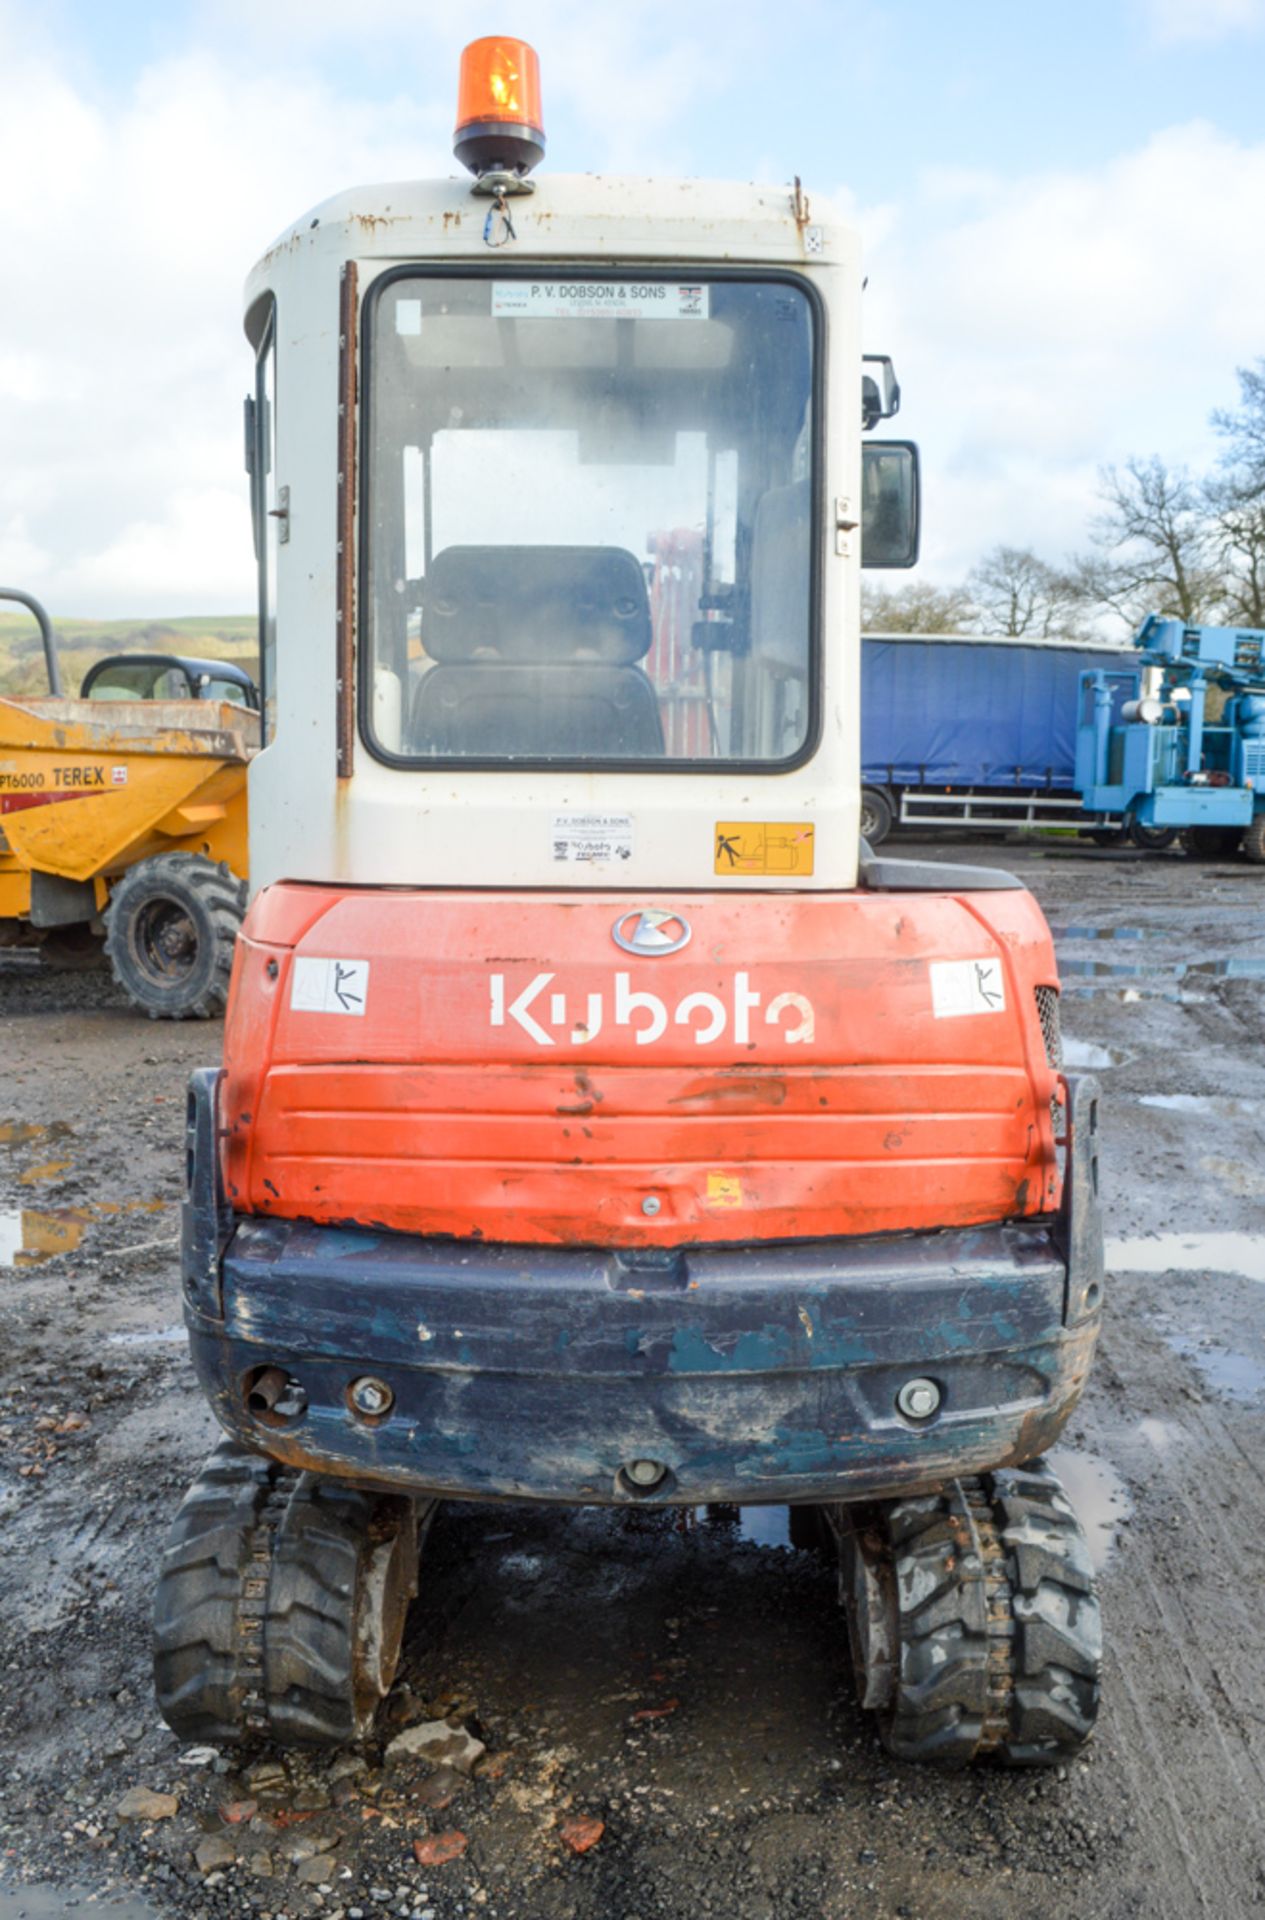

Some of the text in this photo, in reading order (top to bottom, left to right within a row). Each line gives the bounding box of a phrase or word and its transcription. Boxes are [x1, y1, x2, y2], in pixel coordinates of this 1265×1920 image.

[531, 286, 542, 298] P.
[545, 286, 556, 298] V.
[559, 286, 615, 298] DOBSON
[617, 286, 627, 298] &
[630, 286, 666, 299] SONS
[53, 767, 105, 786] TEREX
[489, 972, 815, 1045] Kubota
